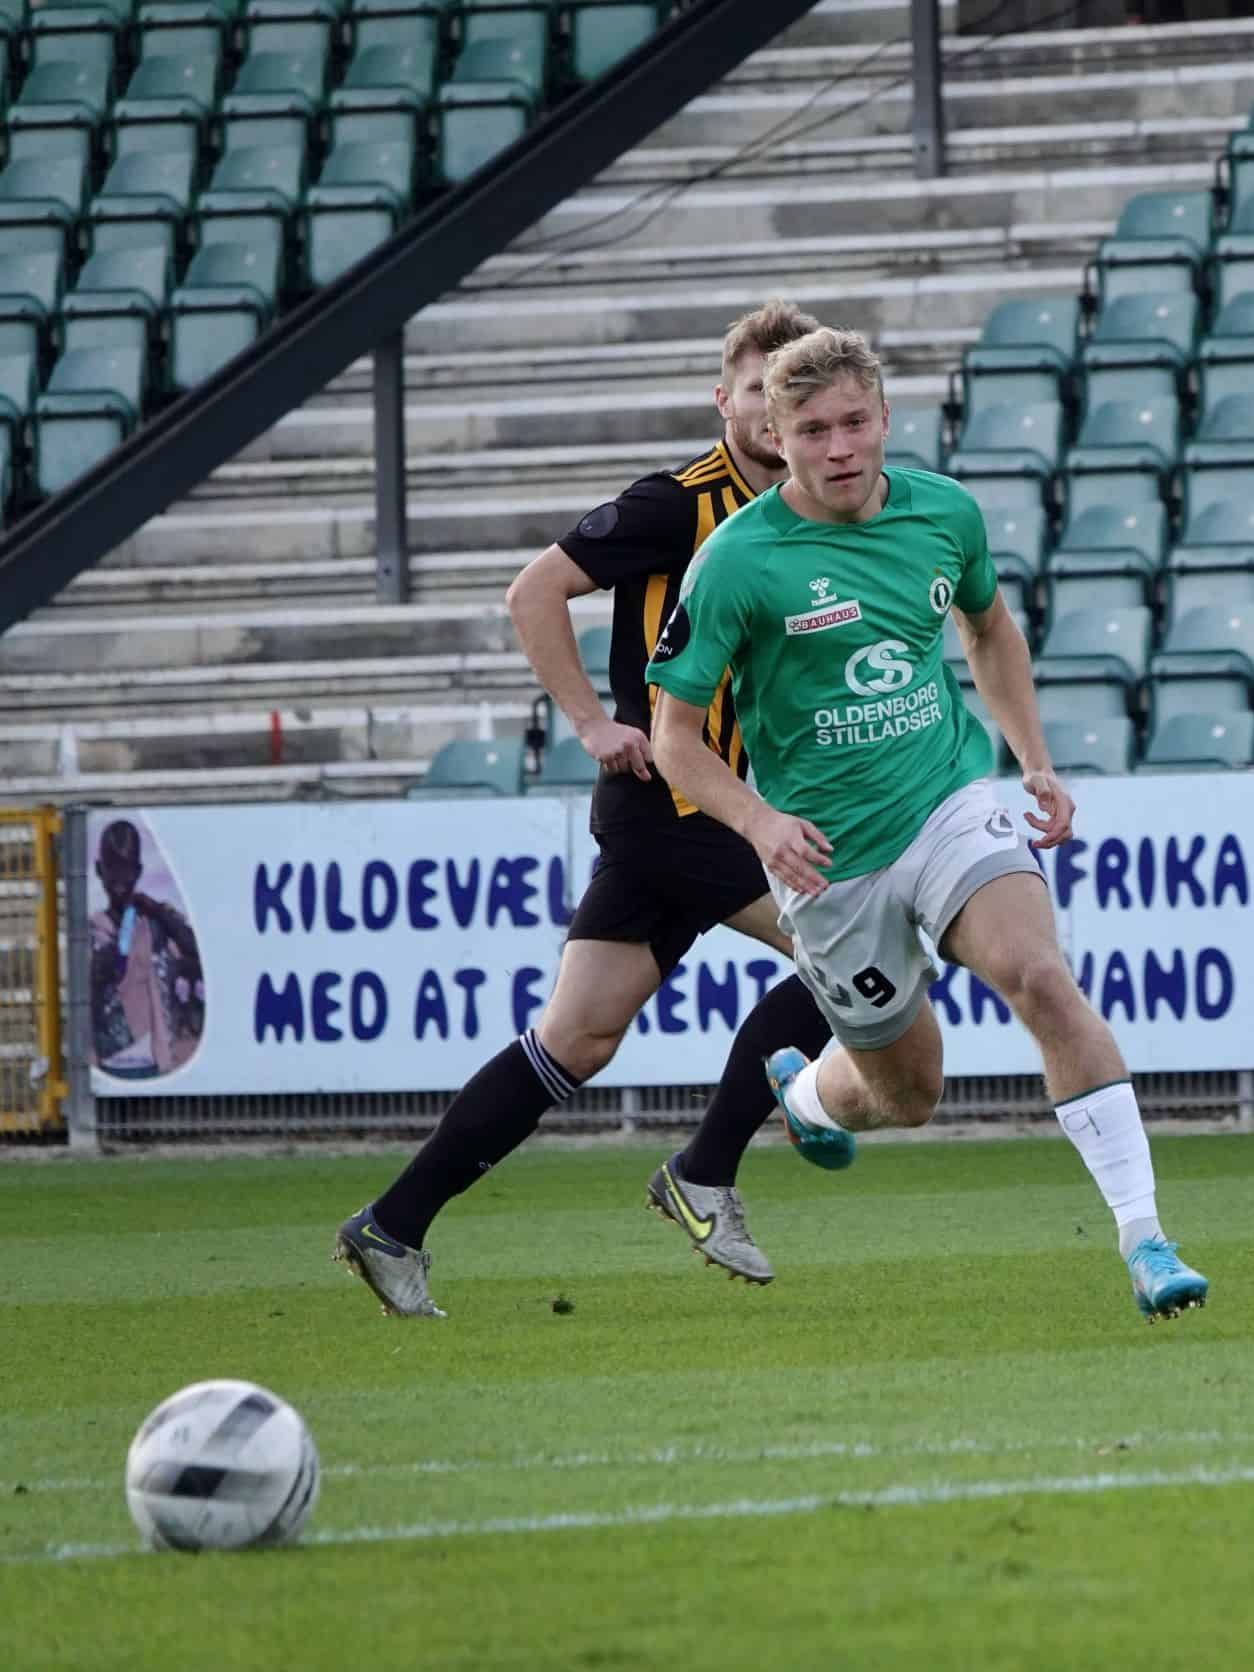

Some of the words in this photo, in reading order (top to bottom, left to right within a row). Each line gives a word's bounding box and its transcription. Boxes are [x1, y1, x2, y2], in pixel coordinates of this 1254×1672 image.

[801, 606, 858, 630] BAUHAUS
[814, 683, 938, 728] OLDENBORG
[816, 702, 942, 745] STILLADSER
[255, 855, 600, 933] KILDEVÆL
[254, 970, 388, 1043] MED
[415, 966, 487, 1041] AT
[637, 959, 779, 1034] ENT
[852, 966, 897, 1008] 9
